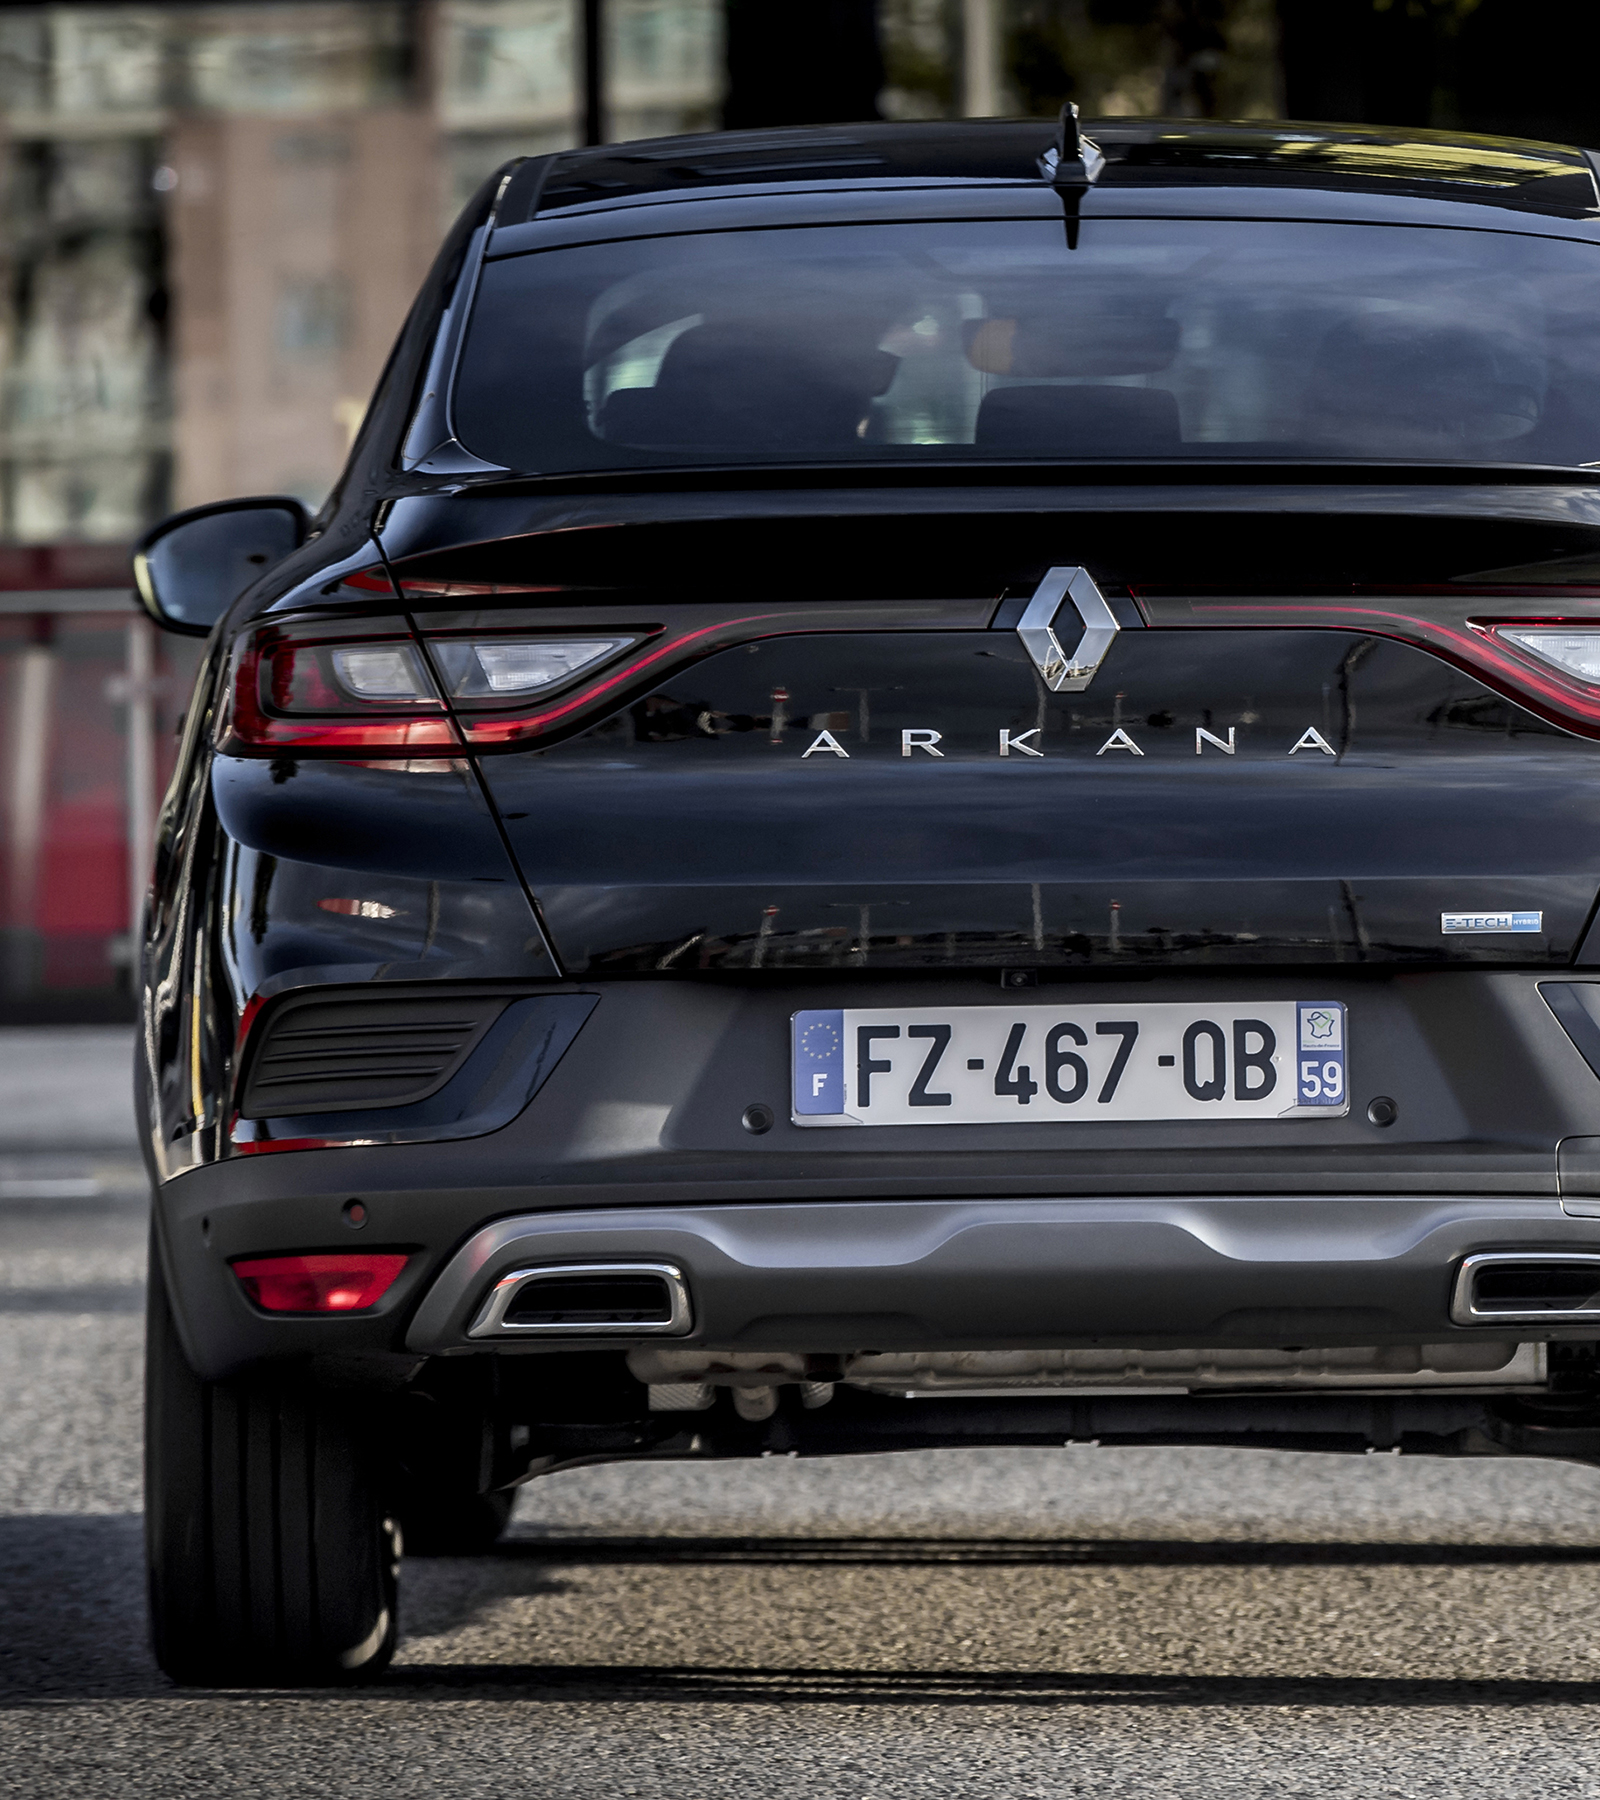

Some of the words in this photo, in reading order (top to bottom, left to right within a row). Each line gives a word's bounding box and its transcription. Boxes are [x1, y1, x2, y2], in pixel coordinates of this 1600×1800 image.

[801, 726, 1337, 759] ARKANA
[1445, 918, 1508, 928] E-TECH
[856, 1018, 1278, 1108] FZ-467-QB
[1301, 1060, 1343, 1098] 59
[813, 1073, 828, 1096] F
